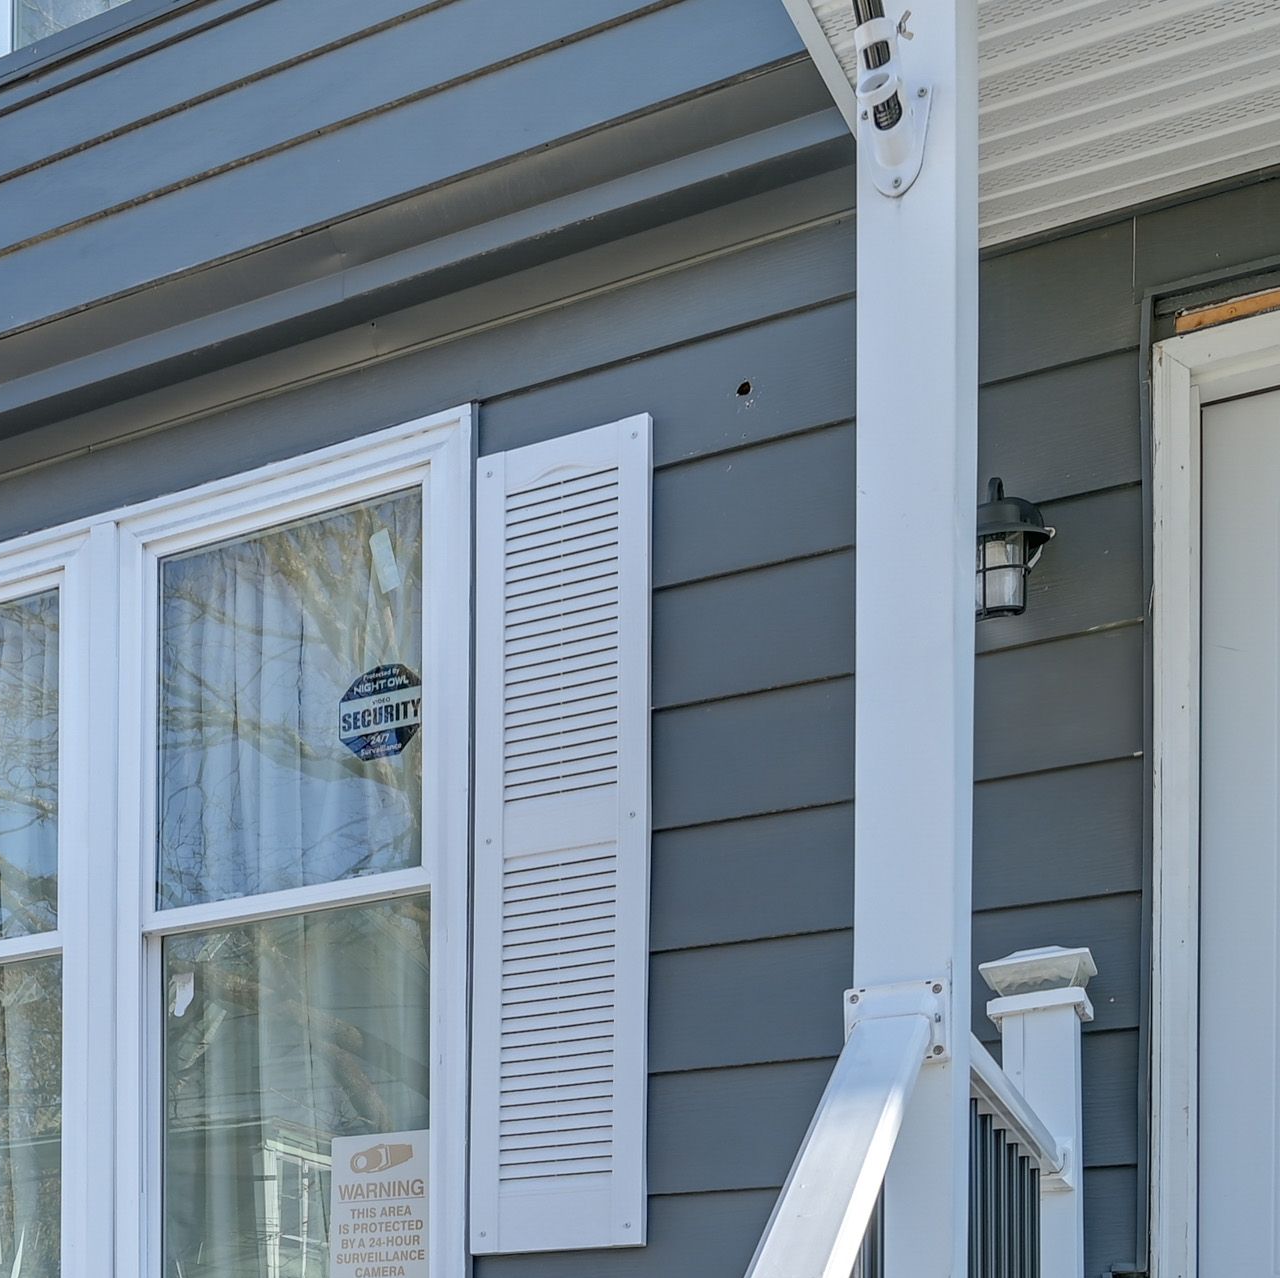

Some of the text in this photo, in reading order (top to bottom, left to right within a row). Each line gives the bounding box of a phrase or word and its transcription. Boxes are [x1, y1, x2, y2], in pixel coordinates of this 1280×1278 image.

[353, 675, 409, 695] NIGHT OWL
[372, 697, 390, 705] VIDEO
[342, 698, 421, 732] SECURITY
[370, 733, 389, 746] 24/7
[338, 1179, 425, 1200] WARNING
[351, 1205, 412, 1219] THIS AREA
[338, 1219, 423, 1235] IS PROTECTED
[341, 1235, 420, 1249] BY A 24-HOUR
[336, 1249, 425, 1264] SURVEILLANCE
[355, 1266, 405, 1278] CAMERA
